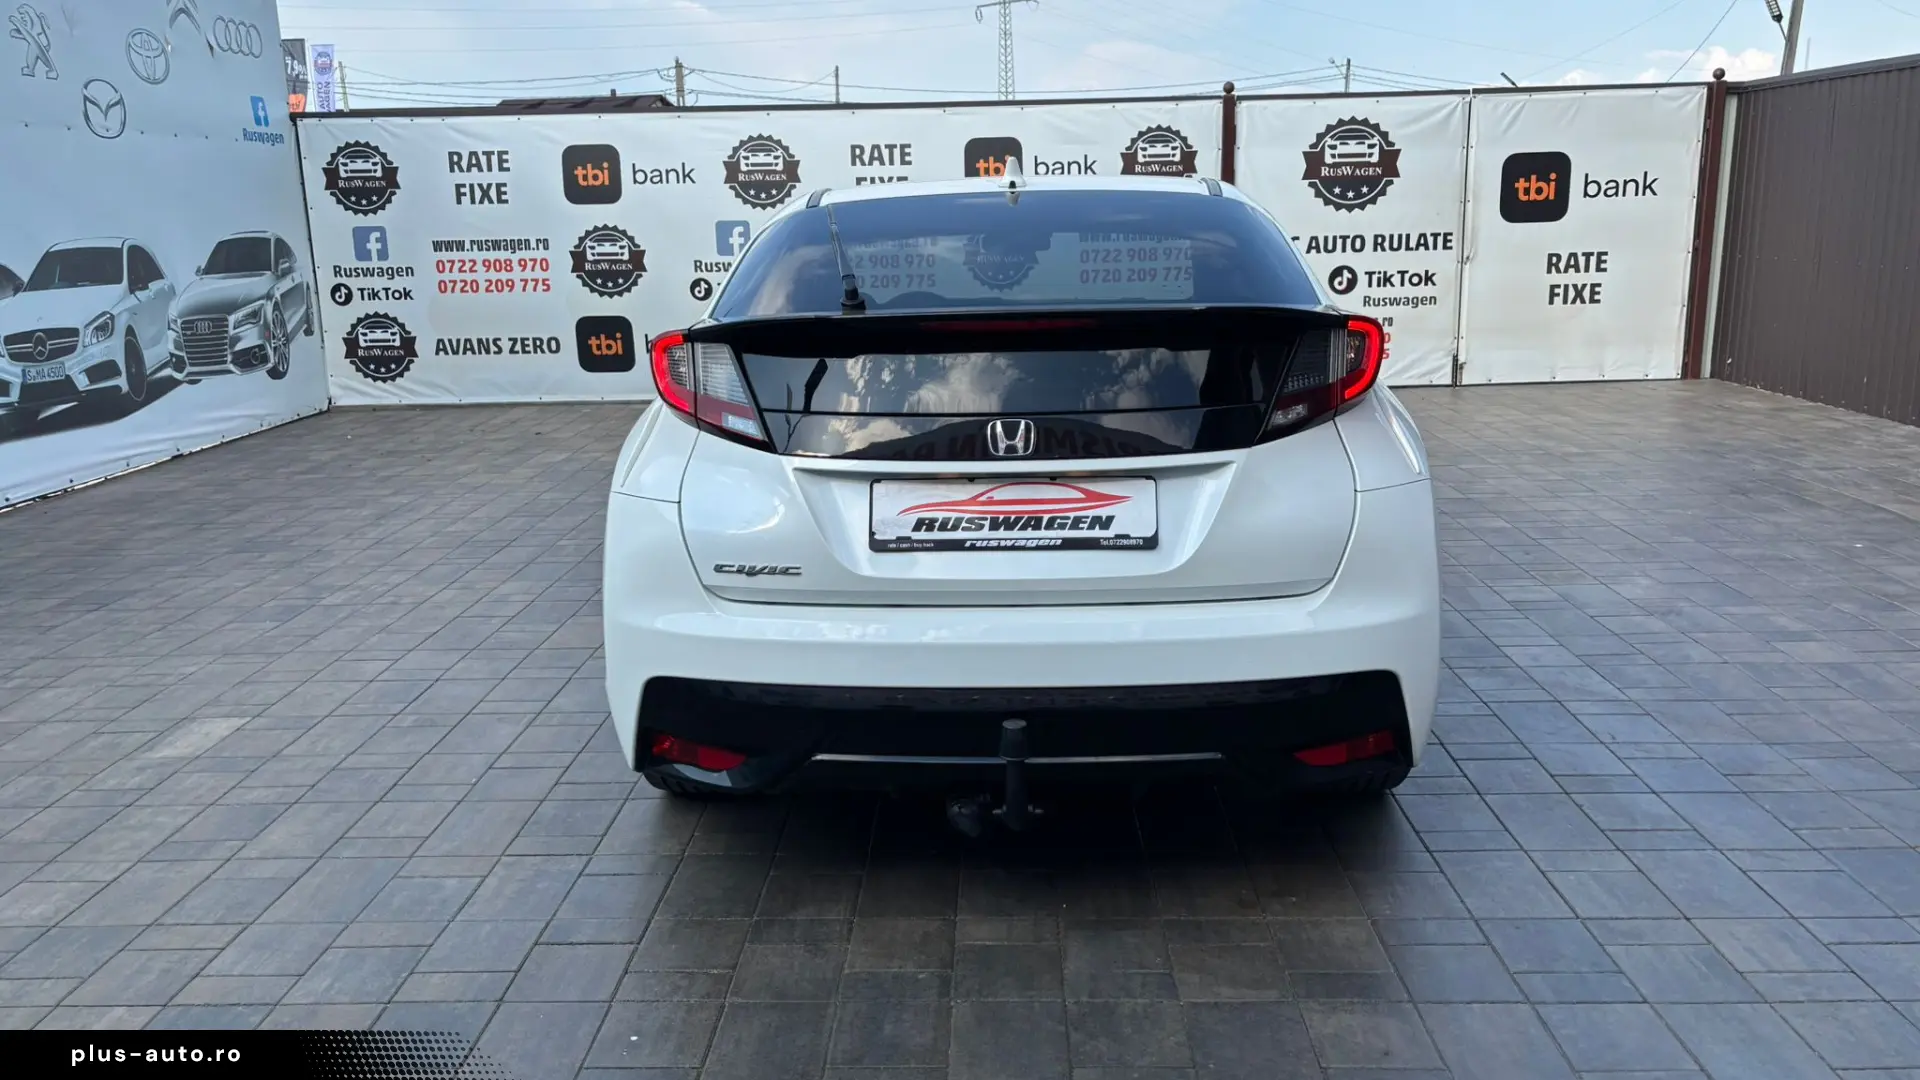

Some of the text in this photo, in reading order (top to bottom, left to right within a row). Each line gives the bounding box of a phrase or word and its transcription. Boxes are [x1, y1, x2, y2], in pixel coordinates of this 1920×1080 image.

[242, 128, 285, 147] Ruswagen
[447, 150, 511, 173] RATE
[850, 143, 912, 166] RATE
[1034, 154, 1098, 175] bank
[574, 162, 697, 186] tbi bank
[454, 182, 509, 205] FIXE
[1514, 170, 1659, 202] tbi bank
[432, 237, 550, 254] www.ruswagen.ro
[1305, 232, 1453, 254] AUTO RULATE
[868, 254, 900, 269] 908
[904, 253, 936, 268] 970
[1079, 249, 1122, 264] 0722
[1127, 247, 1159, 262] 908
[1546, 251, 1609, 274] RATE
[332, 264, 415, 280] Ruswagen
[435, 257, 550, 274] 0722 908 970
[870, 273, 900, 289] 209
[905, 273, 937, 288] 775
[1079, 266, 1192, 284] 0720 209 775
[1364, 269, 1437, 288] TikTok
[357, 286, 414, 301] TikTok
[437, 278, 551, 294] 0720 209 775
[1548, 283, 1602, 306] FIXE
[1363, 295, 1437, 308] Ruswagen
[434, 336, 561, 356] AVANS ZERO
[588, 332, 624, 356] tbi
[911, 515, 1116, 532] RUSWAGEN
[964, 538, 1063, 548] ruswagen
[713, 563, 802, 577] CIVIC
